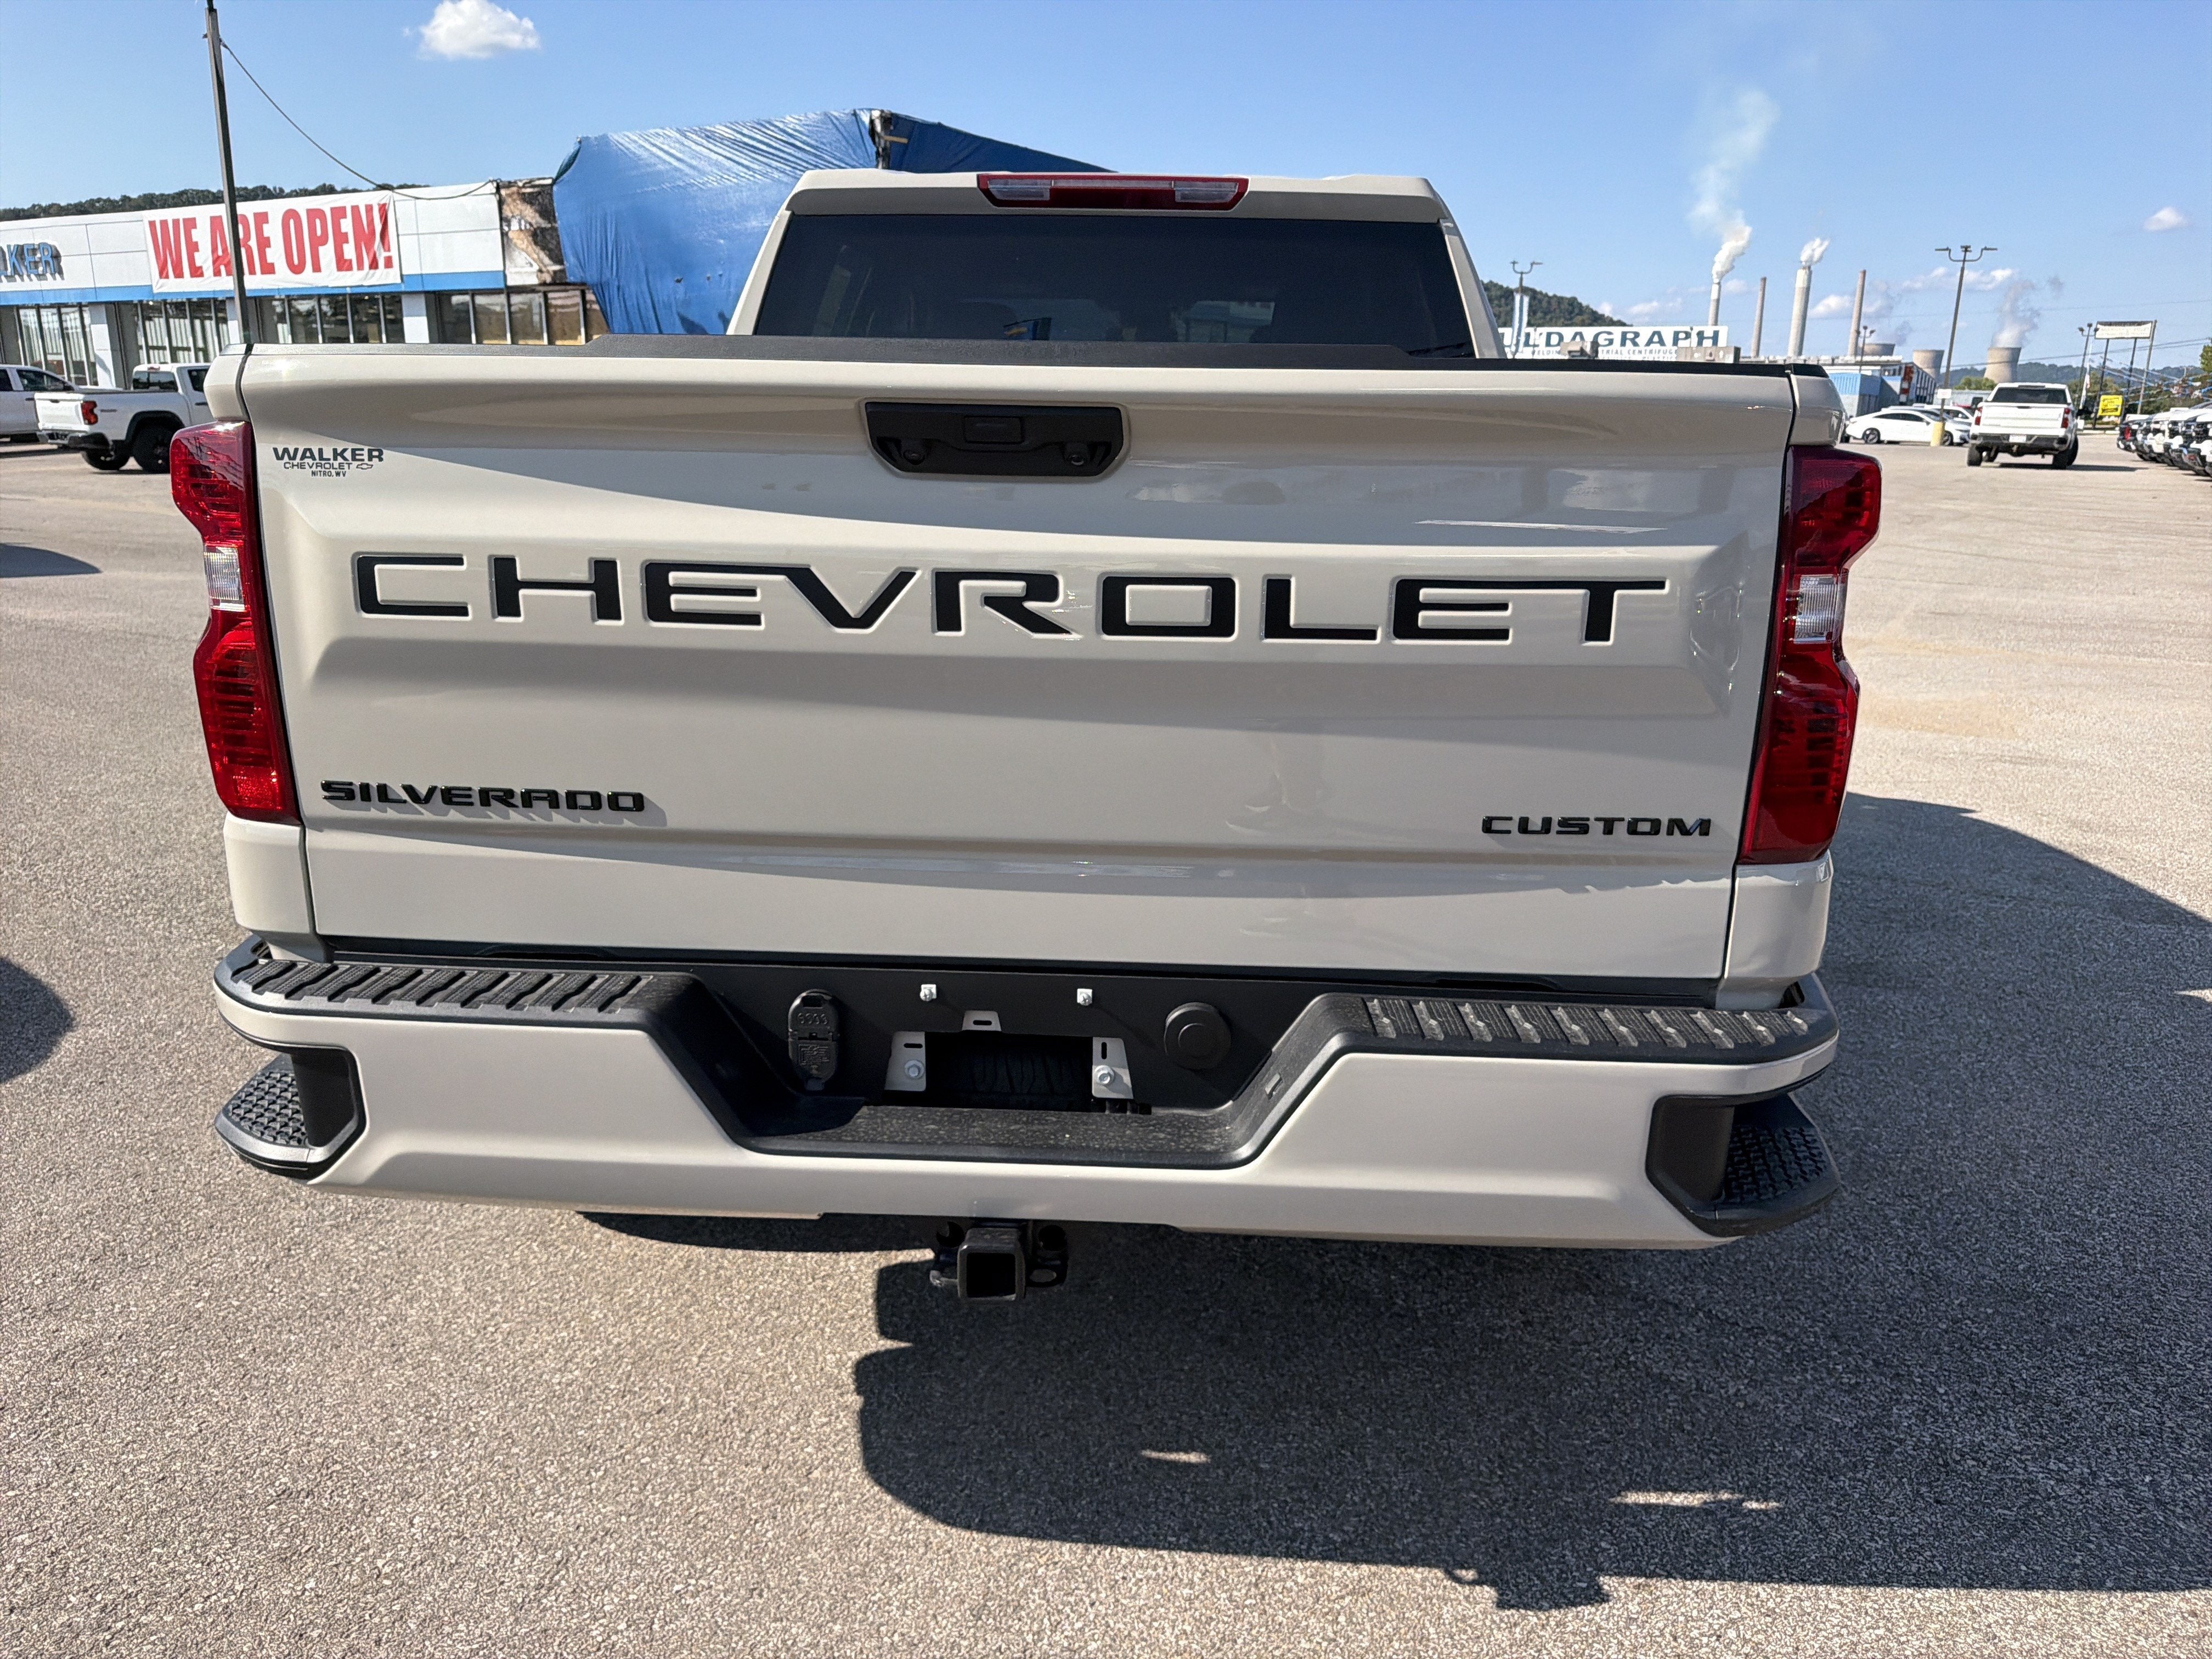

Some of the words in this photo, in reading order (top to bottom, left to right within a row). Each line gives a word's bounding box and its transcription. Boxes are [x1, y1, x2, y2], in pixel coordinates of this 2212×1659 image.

[149, 217, 204, 279] WE
[210, 212, 276, 277] ARE
[281, 203, 393, 275] OPEN!
[272, 447, 384, 462] WALKER
[353, 552, 1667, 645] CHEVROLET
[320, 780, 645, 812] SILVERADO
[1481, 816, 1711, 836] CUSTOM
